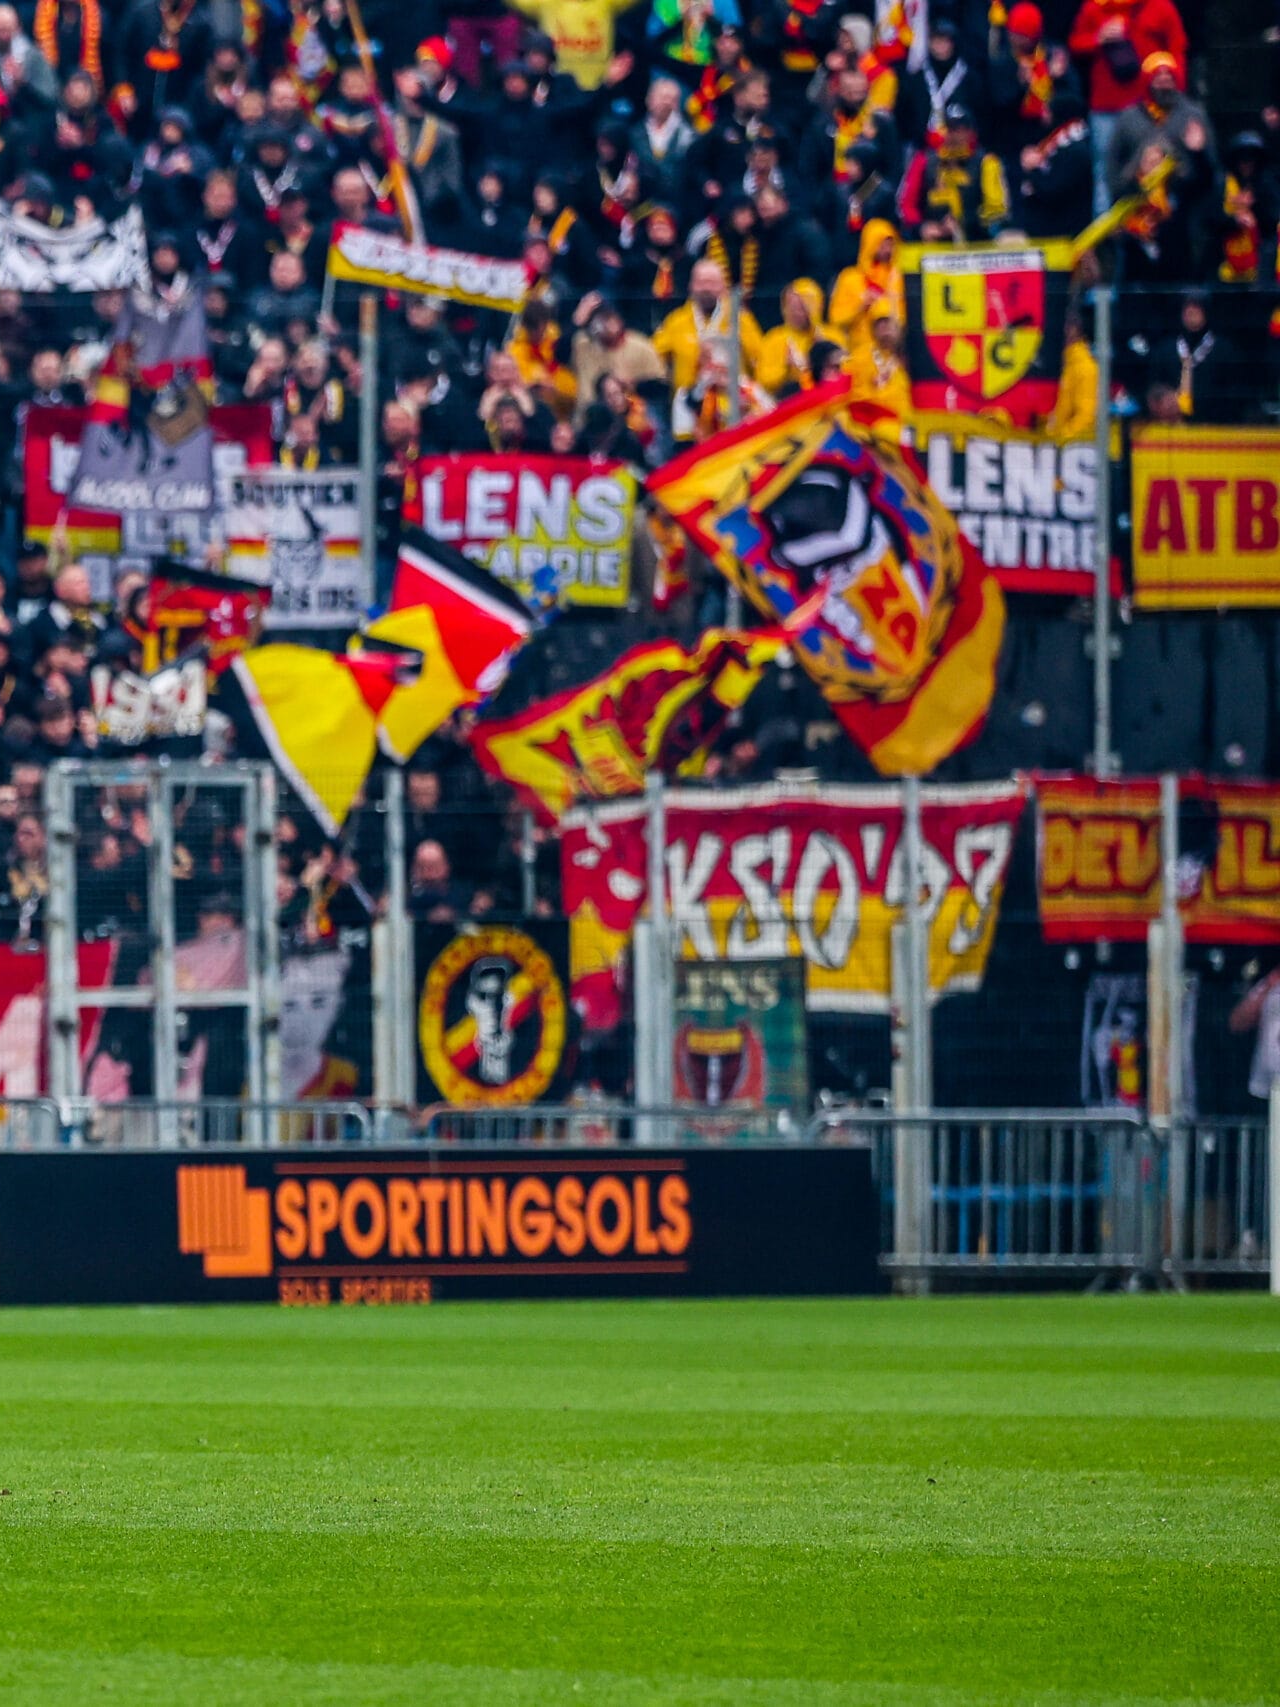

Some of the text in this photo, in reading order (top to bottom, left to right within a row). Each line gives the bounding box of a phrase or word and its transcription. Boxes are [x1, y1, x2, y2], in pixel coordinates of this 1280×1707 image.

[421, 466, 628, 544] LENS
[926, 433, 1098, 522] LENS
[275, 1176, 693, 1261] SPORTINGSOLS
